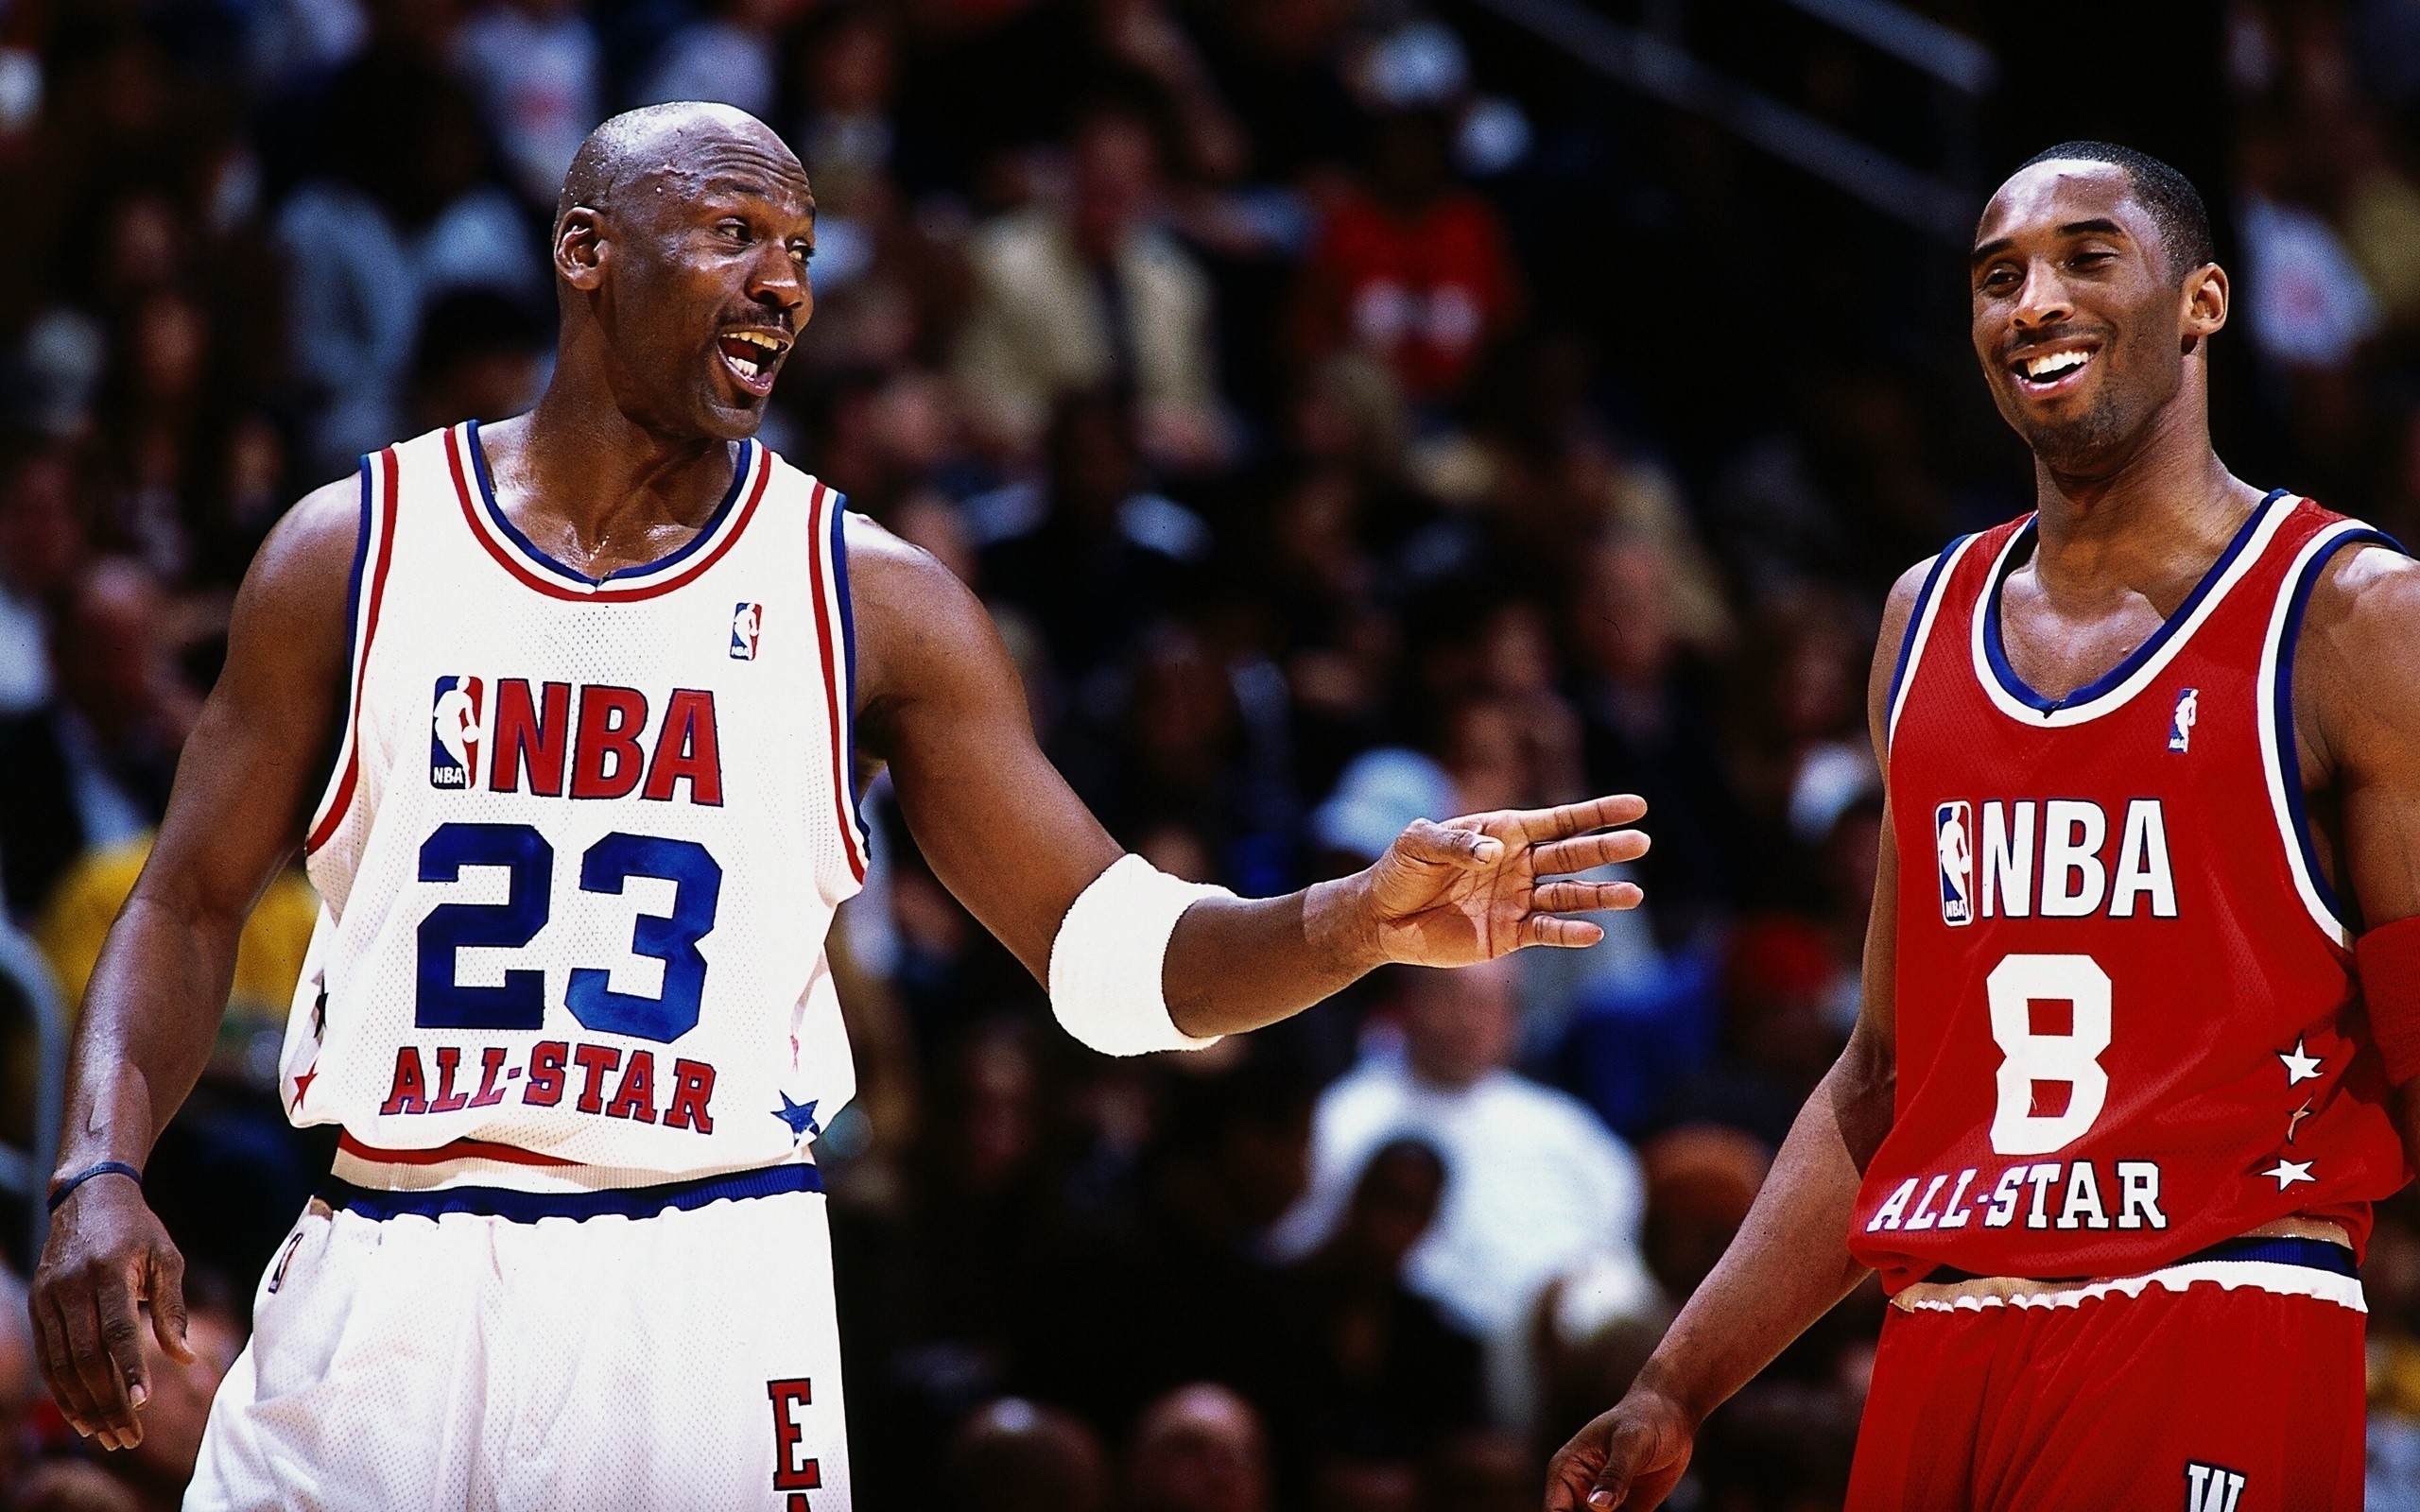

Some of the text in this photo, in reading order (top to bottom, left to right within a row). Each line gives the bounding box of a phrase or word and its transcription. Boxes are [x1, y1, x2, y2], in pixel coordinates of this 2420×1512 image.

[433, 766, 463, 783] NBA
[489, 678, 724, 806] NBA
[1945, 900, 1965, 917] NBA
[1980, 799, 2179, 920] NBA
[414, 821, 723, 1044] 23
[379, 1040, 717, 1135] ALL-STAR
[1986, 954, 2112, 1156] 8
[1865, 1160, 2169, 1232] ALL-STAR
[767, 1377, 822, 1512] E
